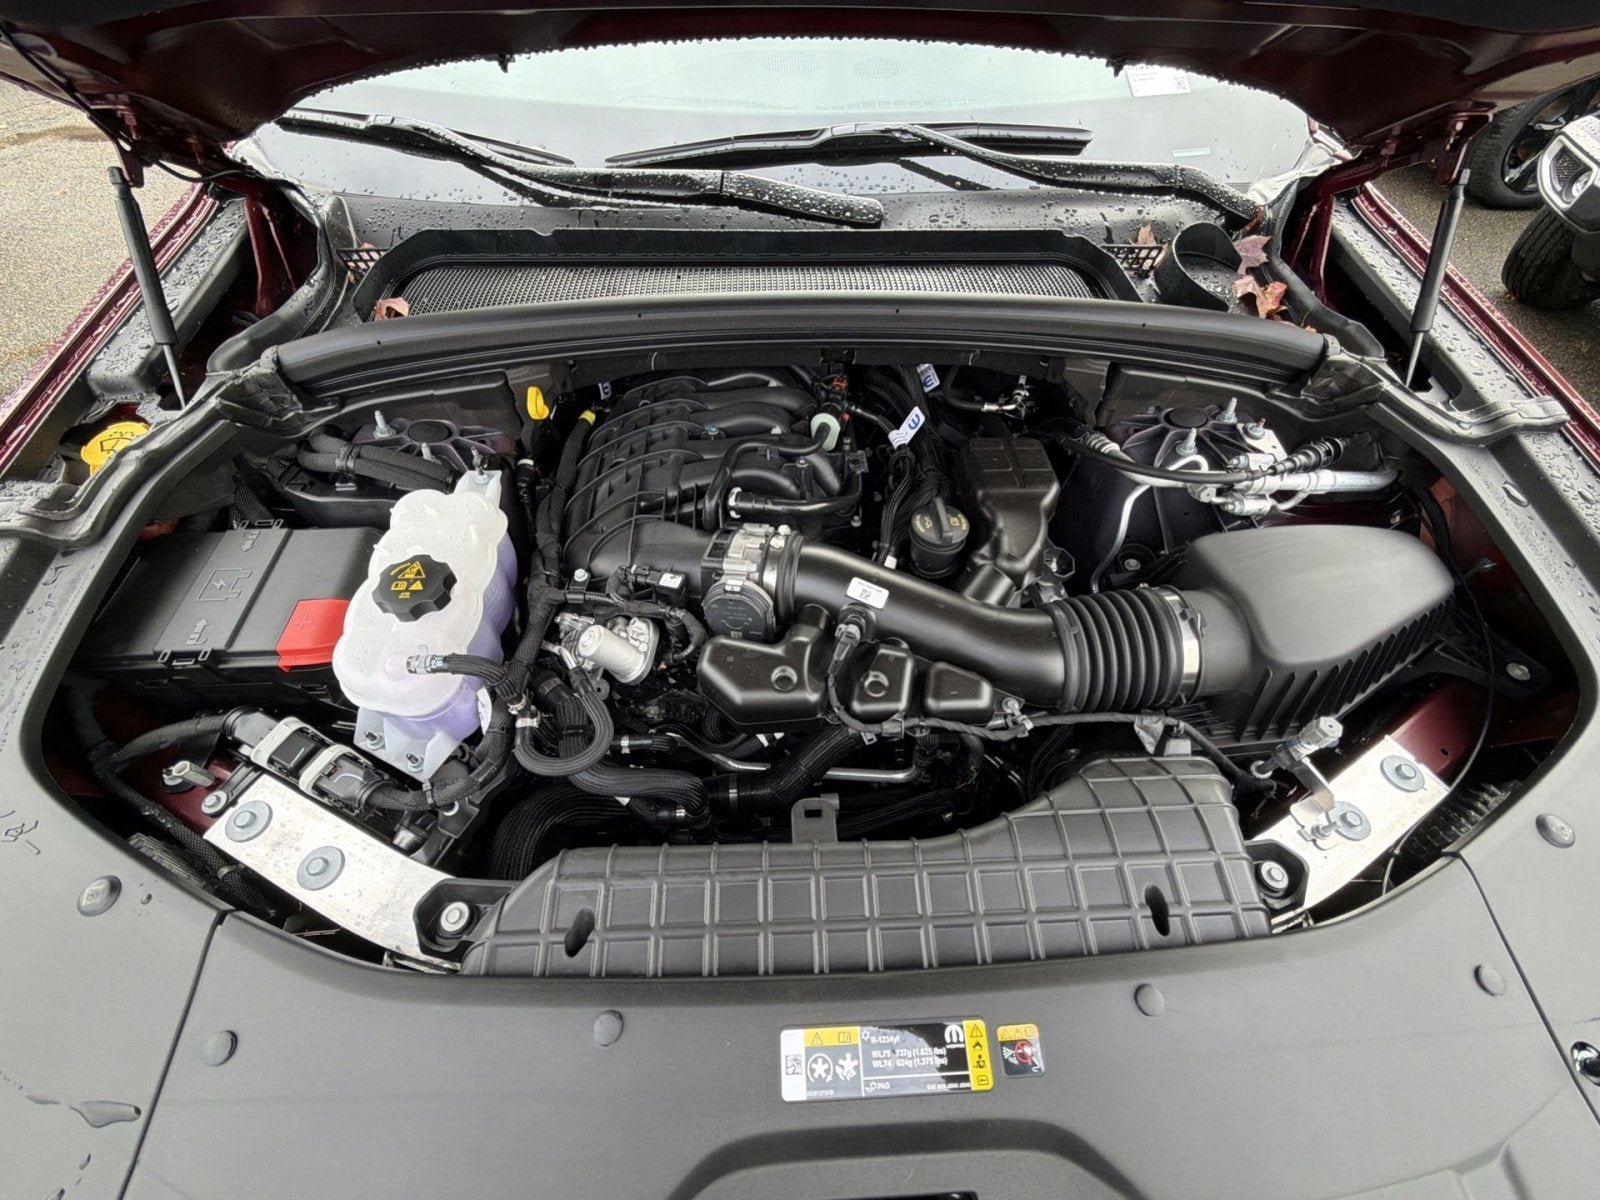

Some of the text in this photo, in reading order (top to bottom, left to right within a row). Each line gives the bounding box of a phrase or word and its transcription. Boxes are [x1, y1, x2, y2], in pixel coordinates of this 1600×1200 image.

[870, 1035, 900, 1045] R-1234yf
[871, 1050, 891, 1058] WL75
[872, 1059, 892, 1068] WL74
